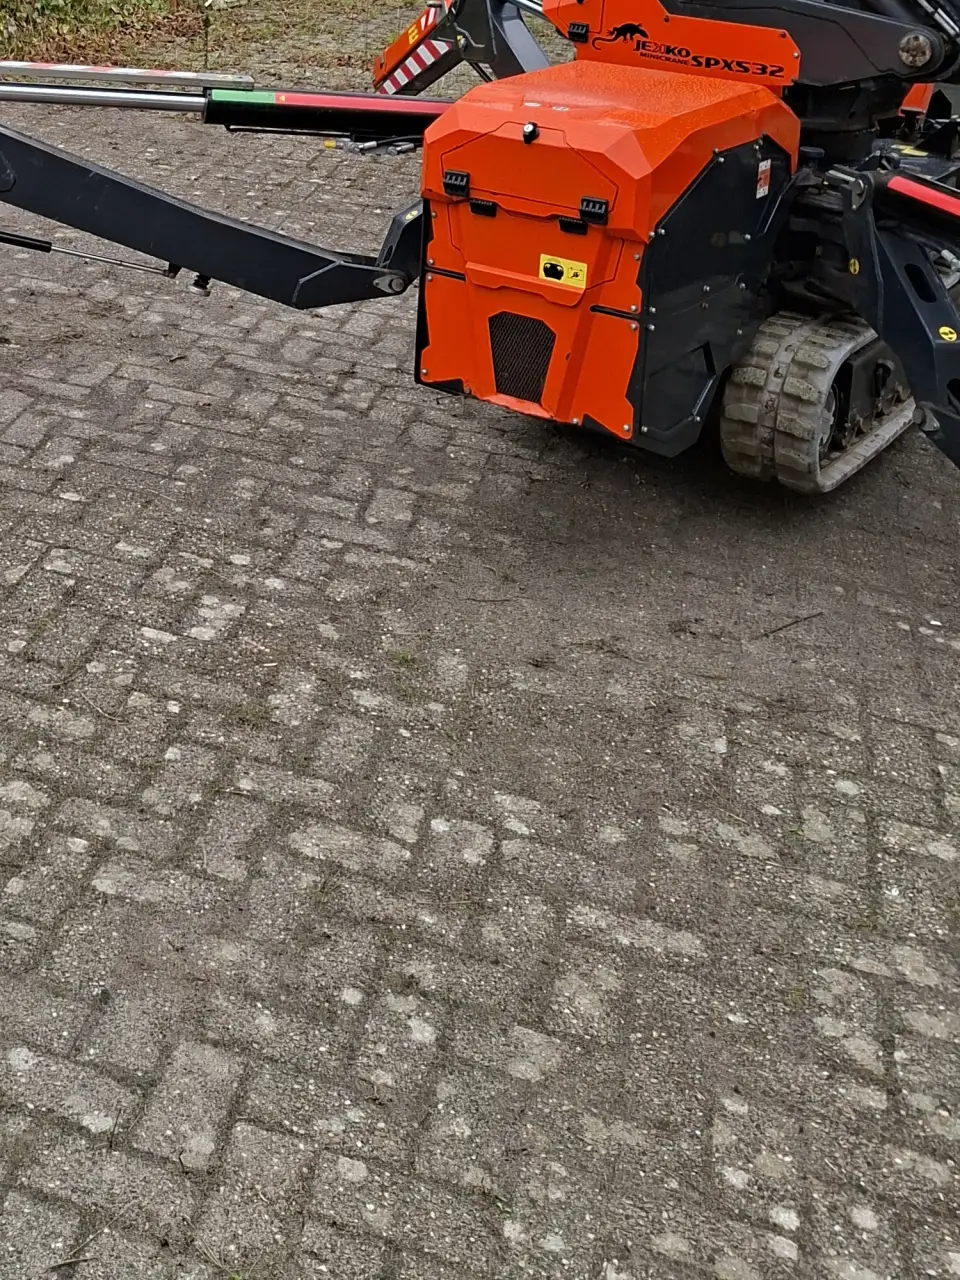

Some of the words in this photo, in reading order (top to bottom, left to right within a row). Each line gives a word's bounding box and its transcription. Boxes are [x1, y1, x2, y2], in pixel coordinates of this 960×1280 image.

[633, 39, 691, 58] JEKKO
[640, 51, 690, 66] MINICRANE
[691, 55, 785, 78] SPX532
